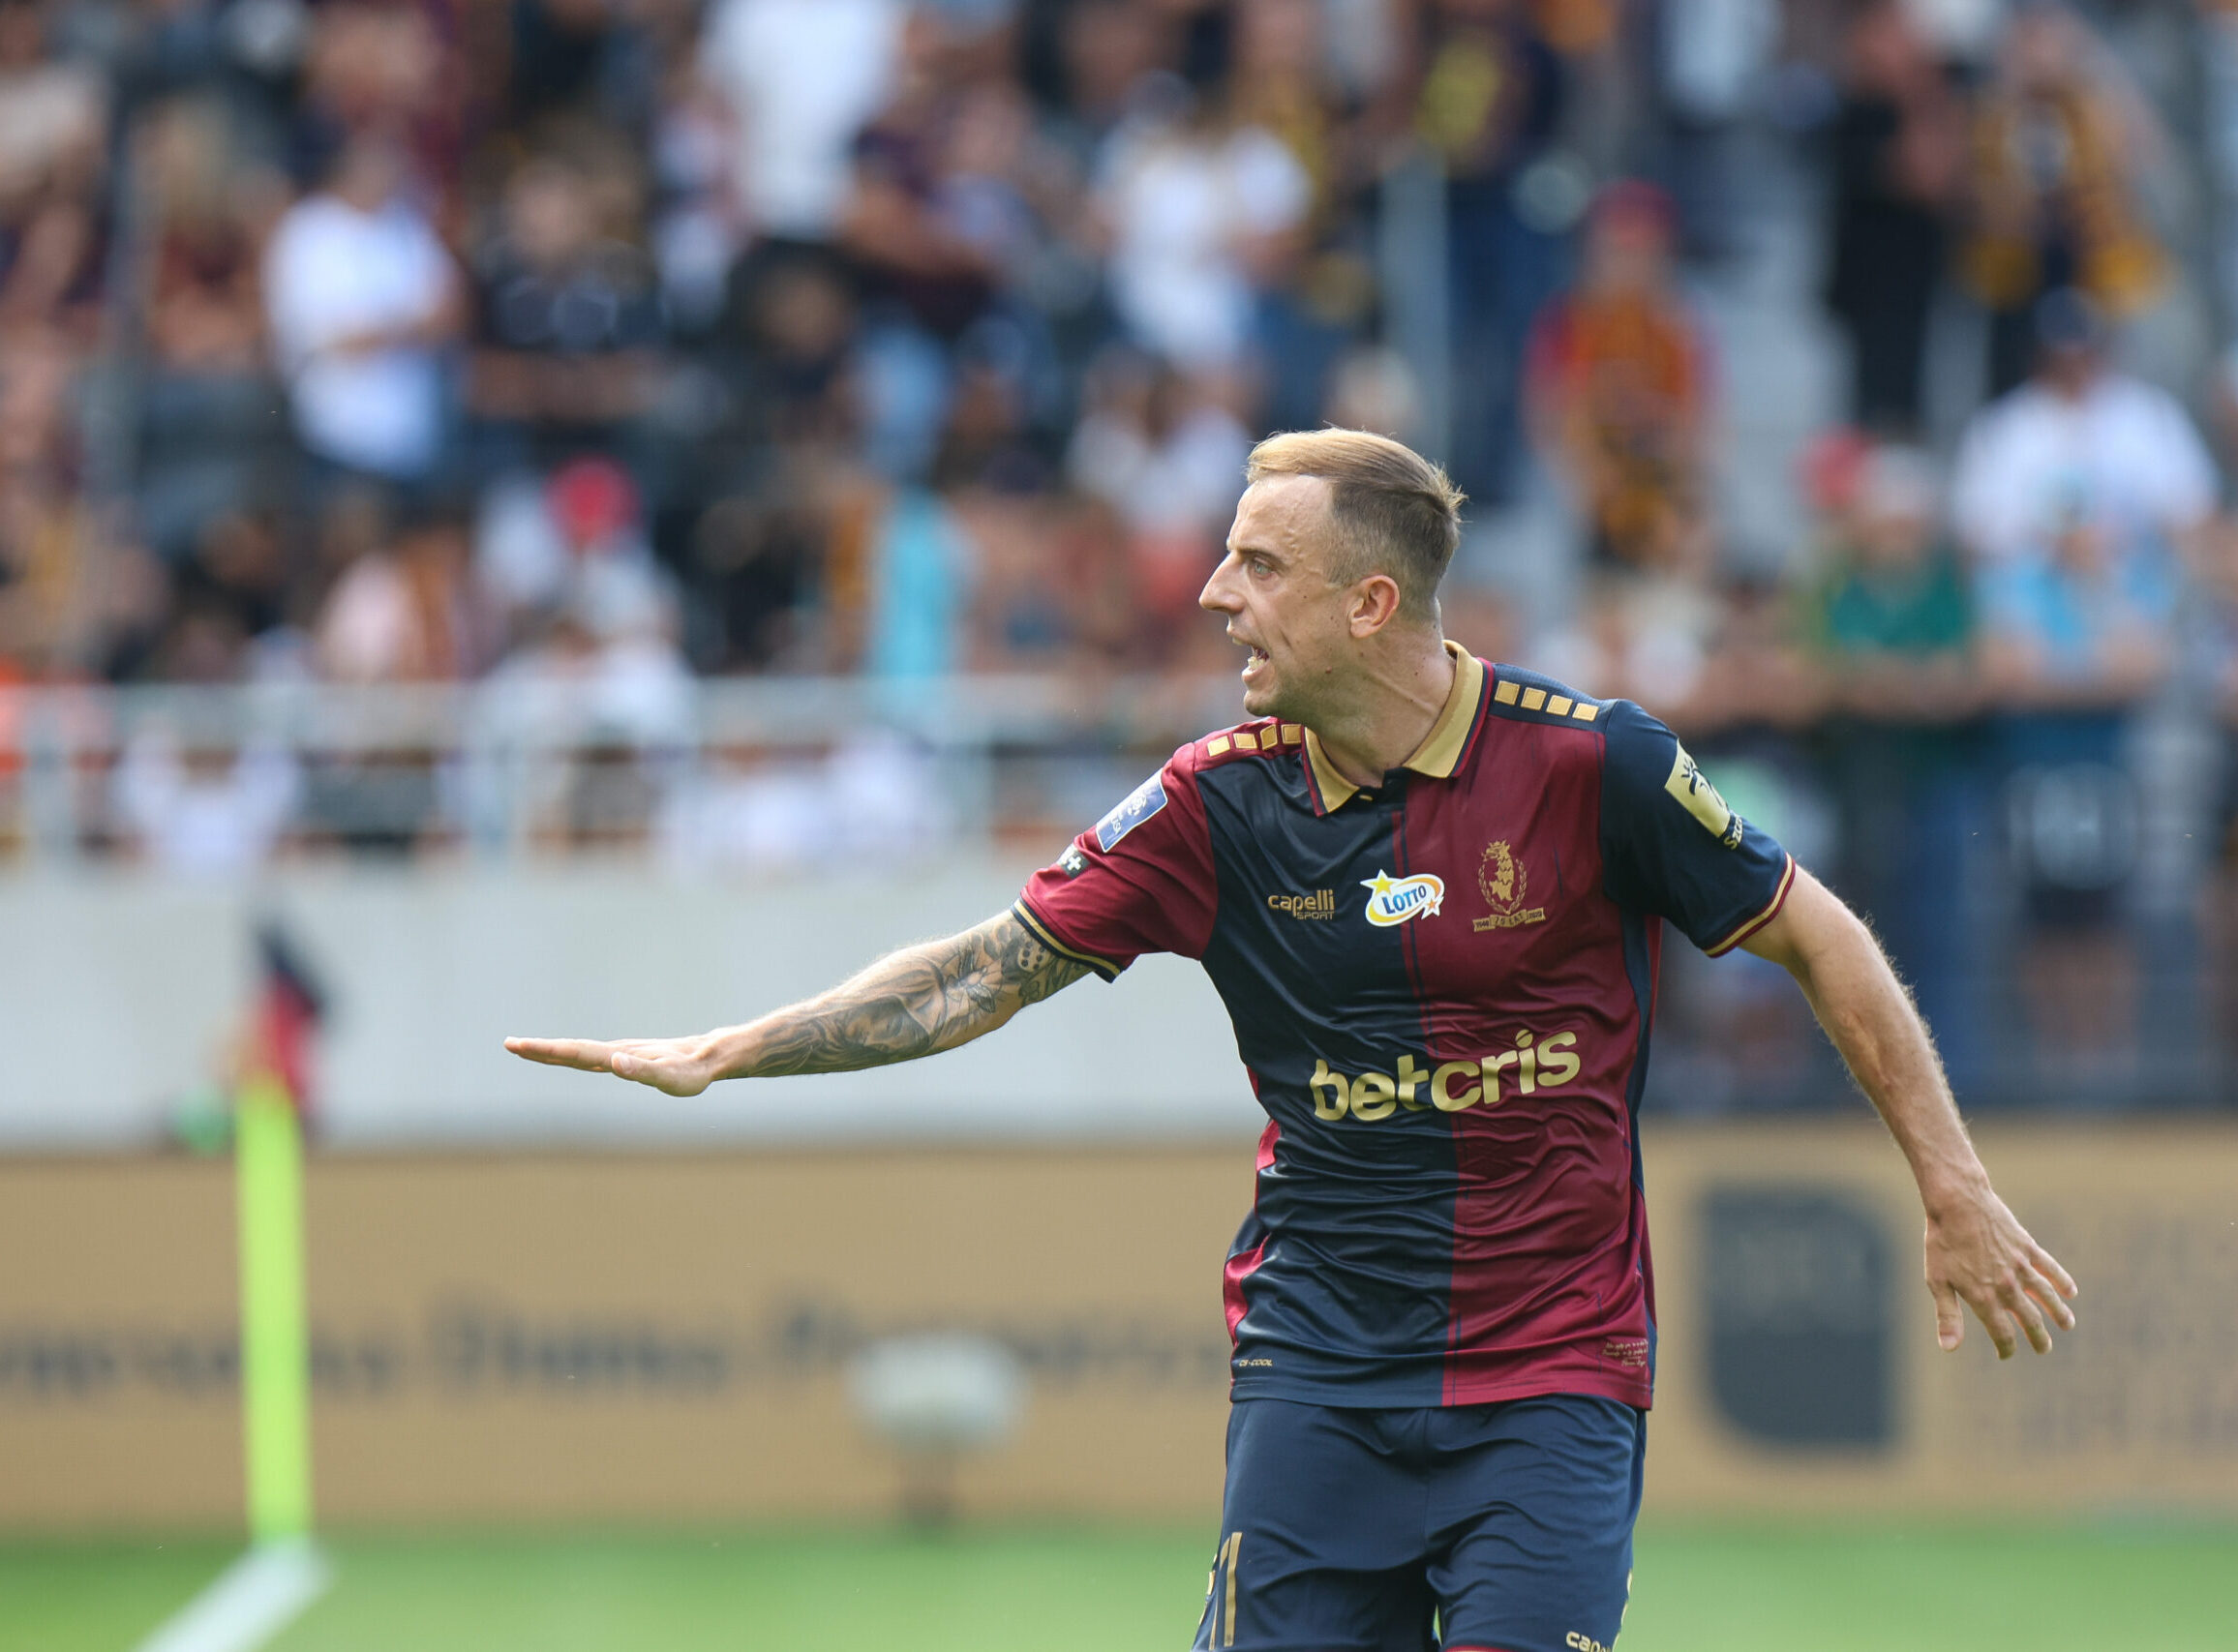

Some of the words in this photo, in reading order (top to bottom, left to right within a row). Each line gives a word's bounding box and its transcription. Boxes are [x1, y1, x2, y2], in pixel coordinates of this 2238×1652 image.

[1267, 889, 1335, 917] capelli
[1382, 885, 1427, 915] LOTTO
[1297, 911, 1335, 920] SPORT
[1310, 1029, 1581, 1122] betcris
